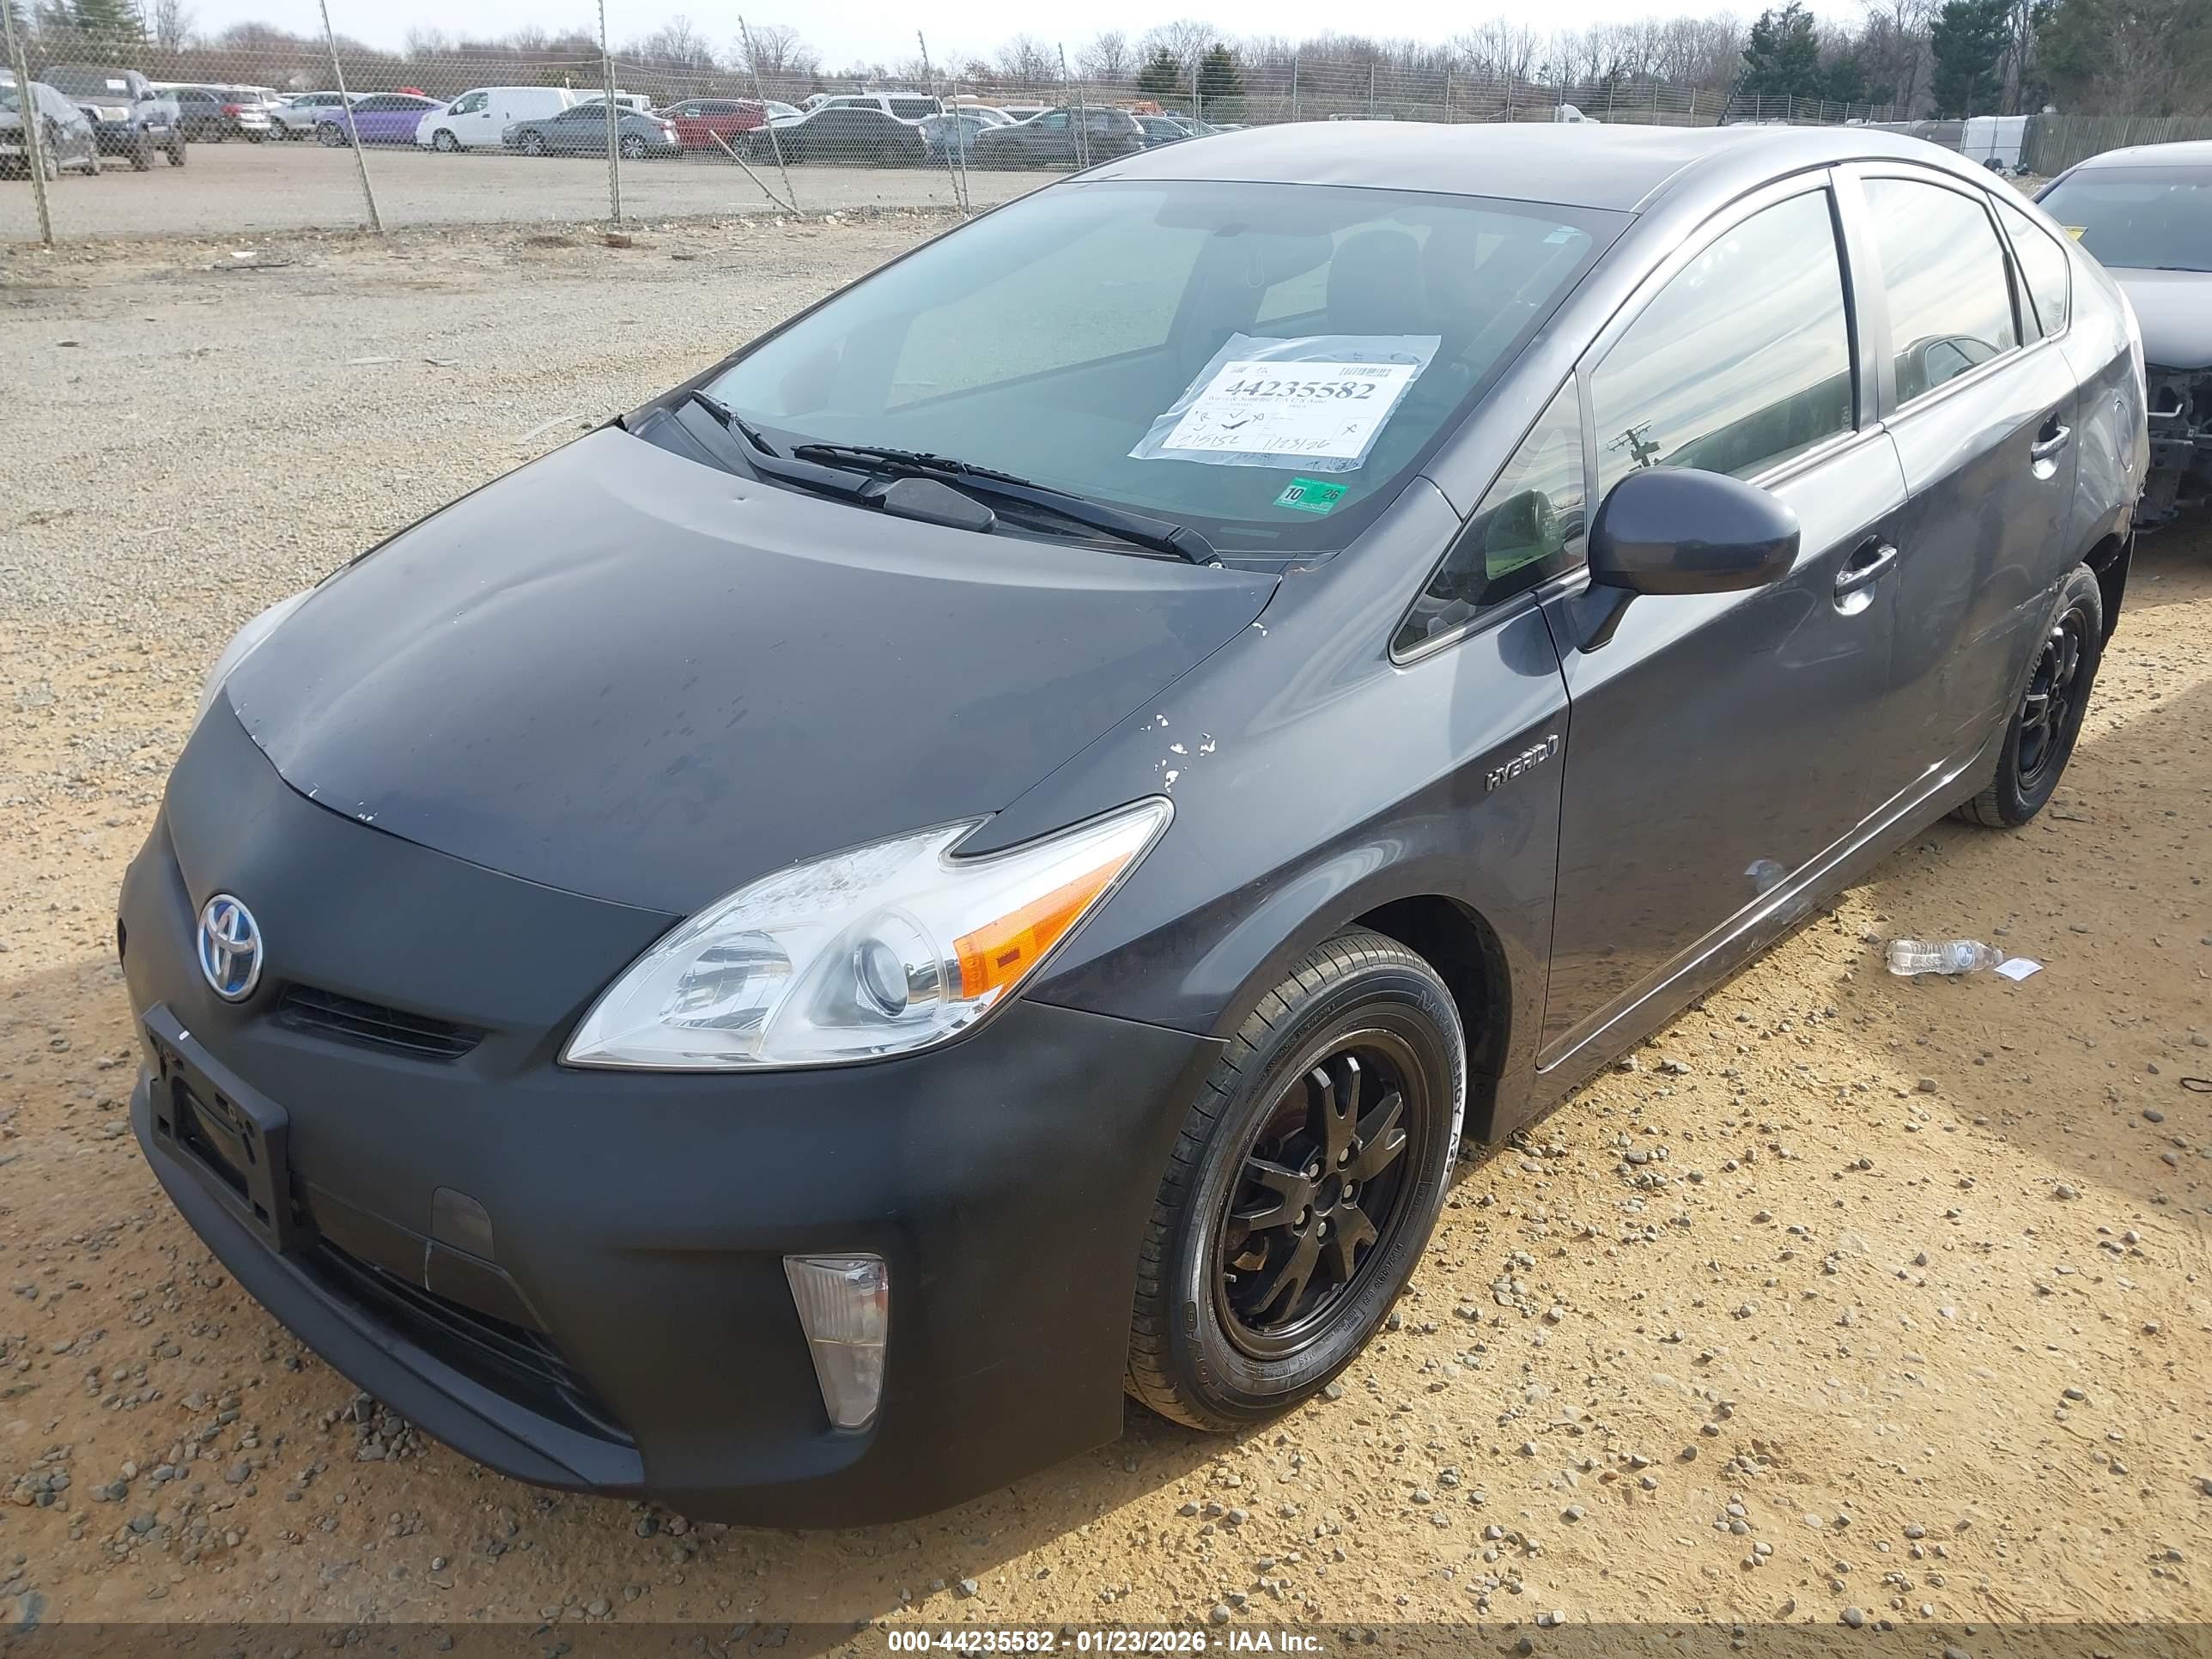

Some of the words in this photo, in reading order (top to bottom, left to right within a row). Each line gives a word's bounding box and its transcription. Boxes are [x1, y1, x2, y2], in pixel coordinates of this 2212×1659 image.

[1225, 380, 1376, 399] 44235582
[1284, 487, 1305, 501] 10
[1322, 489, 1341, 501] 26
[1485, 734, 1559, 792] HYBRID
